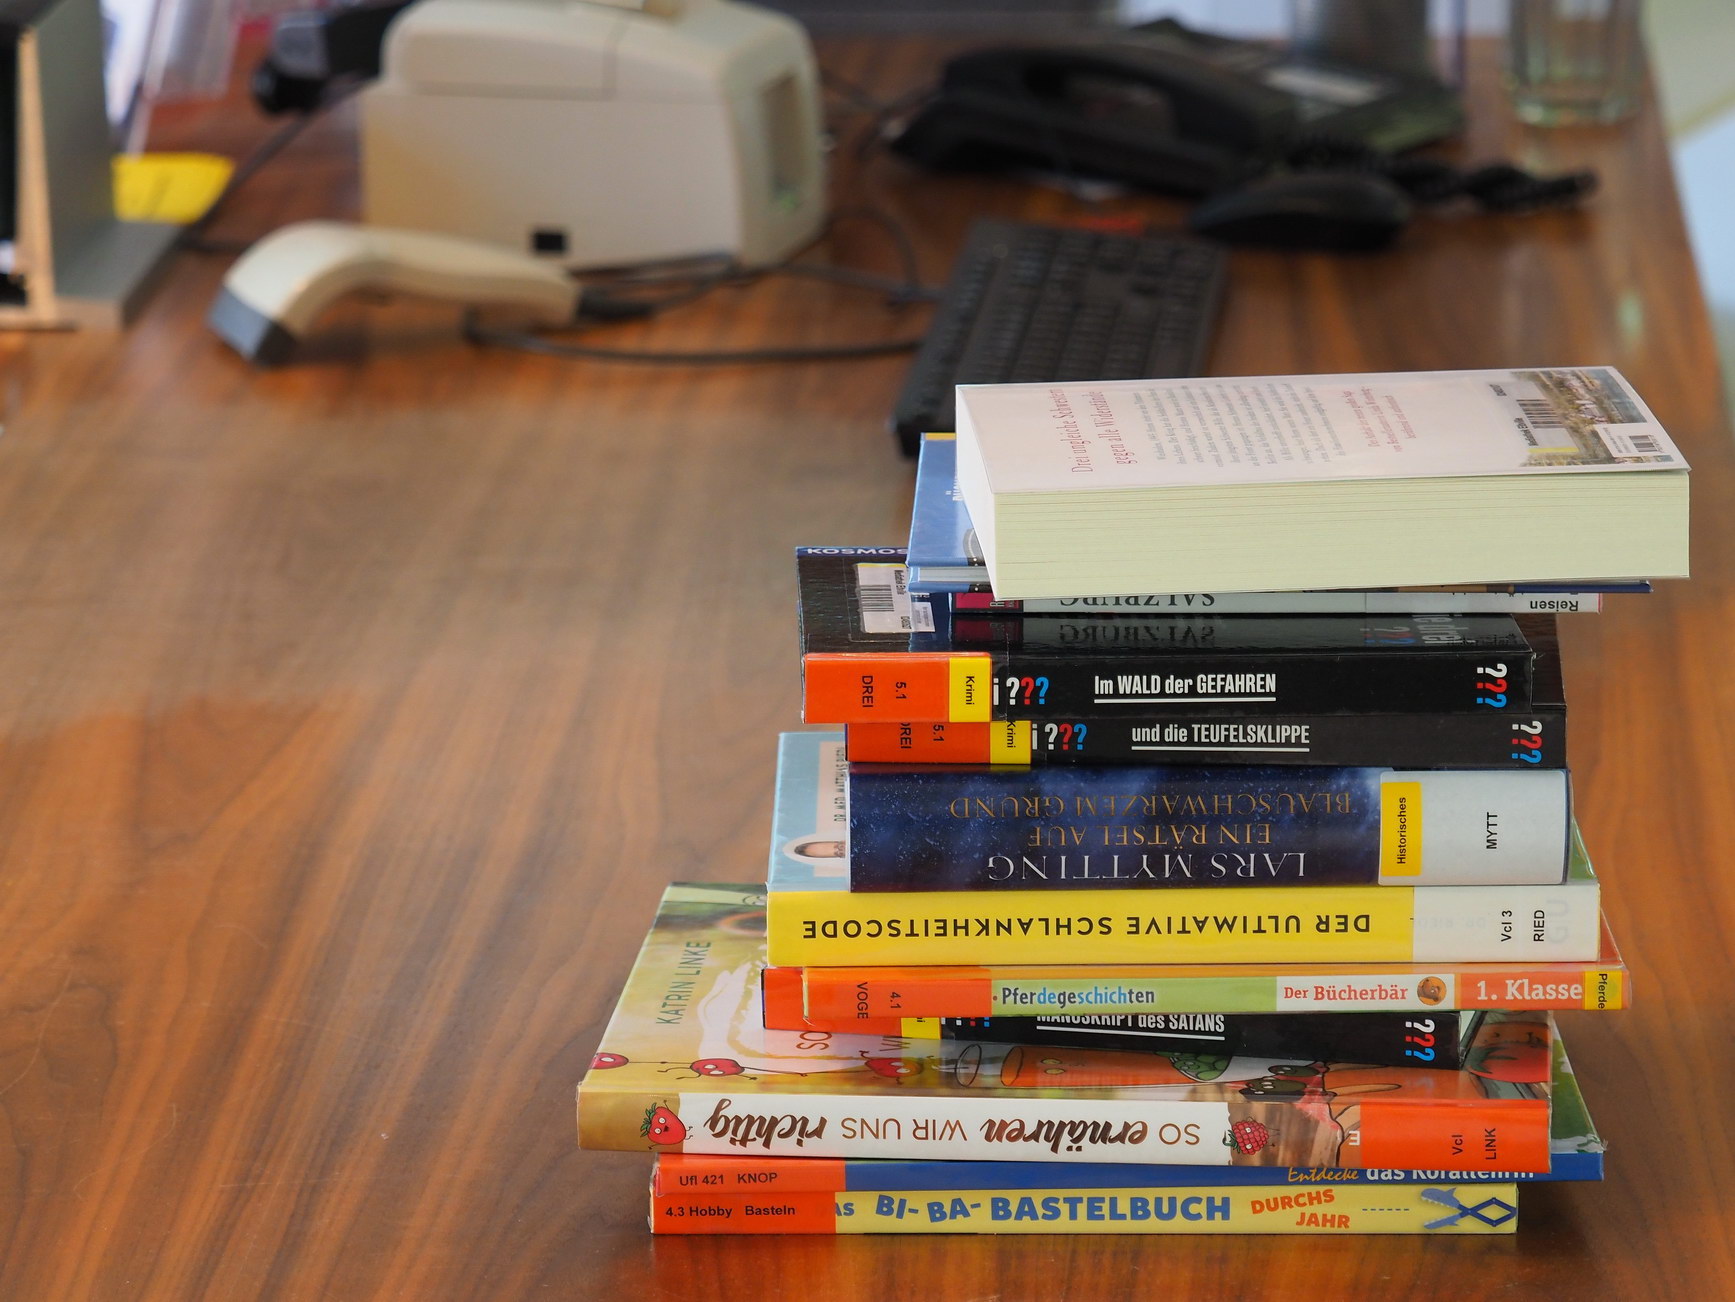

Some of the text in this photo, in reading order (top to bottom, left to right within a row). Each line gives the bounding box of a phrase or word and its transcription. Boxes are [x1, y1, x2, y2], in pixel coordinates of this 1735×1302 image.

[1059, 420, 1092, 454] ungleiche
[1098, 429, 1123, 442] alle
[1069, 456, 1093, 474] Drei
[1108, 444, 1137, 465] gegen
[1530, 600, 1579, 612] Reisen
[861, 675, 874, 708] DREI
[895, 681, 907, 700] 5.1
[965, 675, 975, 706] Krimi
[1094, 676, 1113, 695] Im
[1117, 675, 1162, 694] WALD
[1164, 674, 1193, 694] der
[1196, 673, 1276, 693] GEFAHREN
[933, 724, 945, 742] 5.1
[1132, 725, 1161, 743] und
[1164, 725, 1188, 743] die
[1191, 724, 1310, 743] TEUFELSKLIPPE
[950, 792, 1351, 819] BLAUSCHWARZEM GRUND
[1028, 823, 1270, 850] EIN RÄTSEL AUF
[1397, 797, 1407, 865] Historisches
[1486, 811, 1498, 850] MYTT
[988, 852, 1306, 881] LARS MYTTING
[803, 914, 1370, 939] DER ULTIMATIVE SCHLANKHEITSCODE
[1501, 909, 1513, 942] Vcl 3
[1533, 909, 1544, 942] RIED
[656, 941, 712, 1025] KATRIN LINKE
[1284, 985, 1408, 1000] Der Bücherbär
[1476, 979, 1582, 1000] 1. Klasse
[1598, 973, 1608, 1009] Pferde
[856, 981, 869, 1019] VOGE
[890, 991, 901, 1010] 4.1
[1002, 986, 1155, 1009] Pferdegeschichten
[1138, 1015, 1165, 1029] des
[1169, 1014, 1225, 1033] SATANS
[796, 1031, 832, 1051] SO
[703, 1098, 1201, 1154] SO ernähren WIR UNS richtig
[1451, 1134, 1463, 1156] Vcl
[1485, 1128, 1497, 1160] LINK
[702, 1174, 725, 1185] 421
[737, 1172, 778, 1185] KNOP
[1288, 1167, 1358, 1182] Entdecke
[665, 1204, 796, 1220] 4.3 Hobby Basteln
[835, 1202, 855, 1217] AS
[990, 1196, 1230, 1221] BASTELBUCH
[1250, 1188, 1336, 1216] DURCHS
[1295, 1211, 1350, 1229] JAHR
